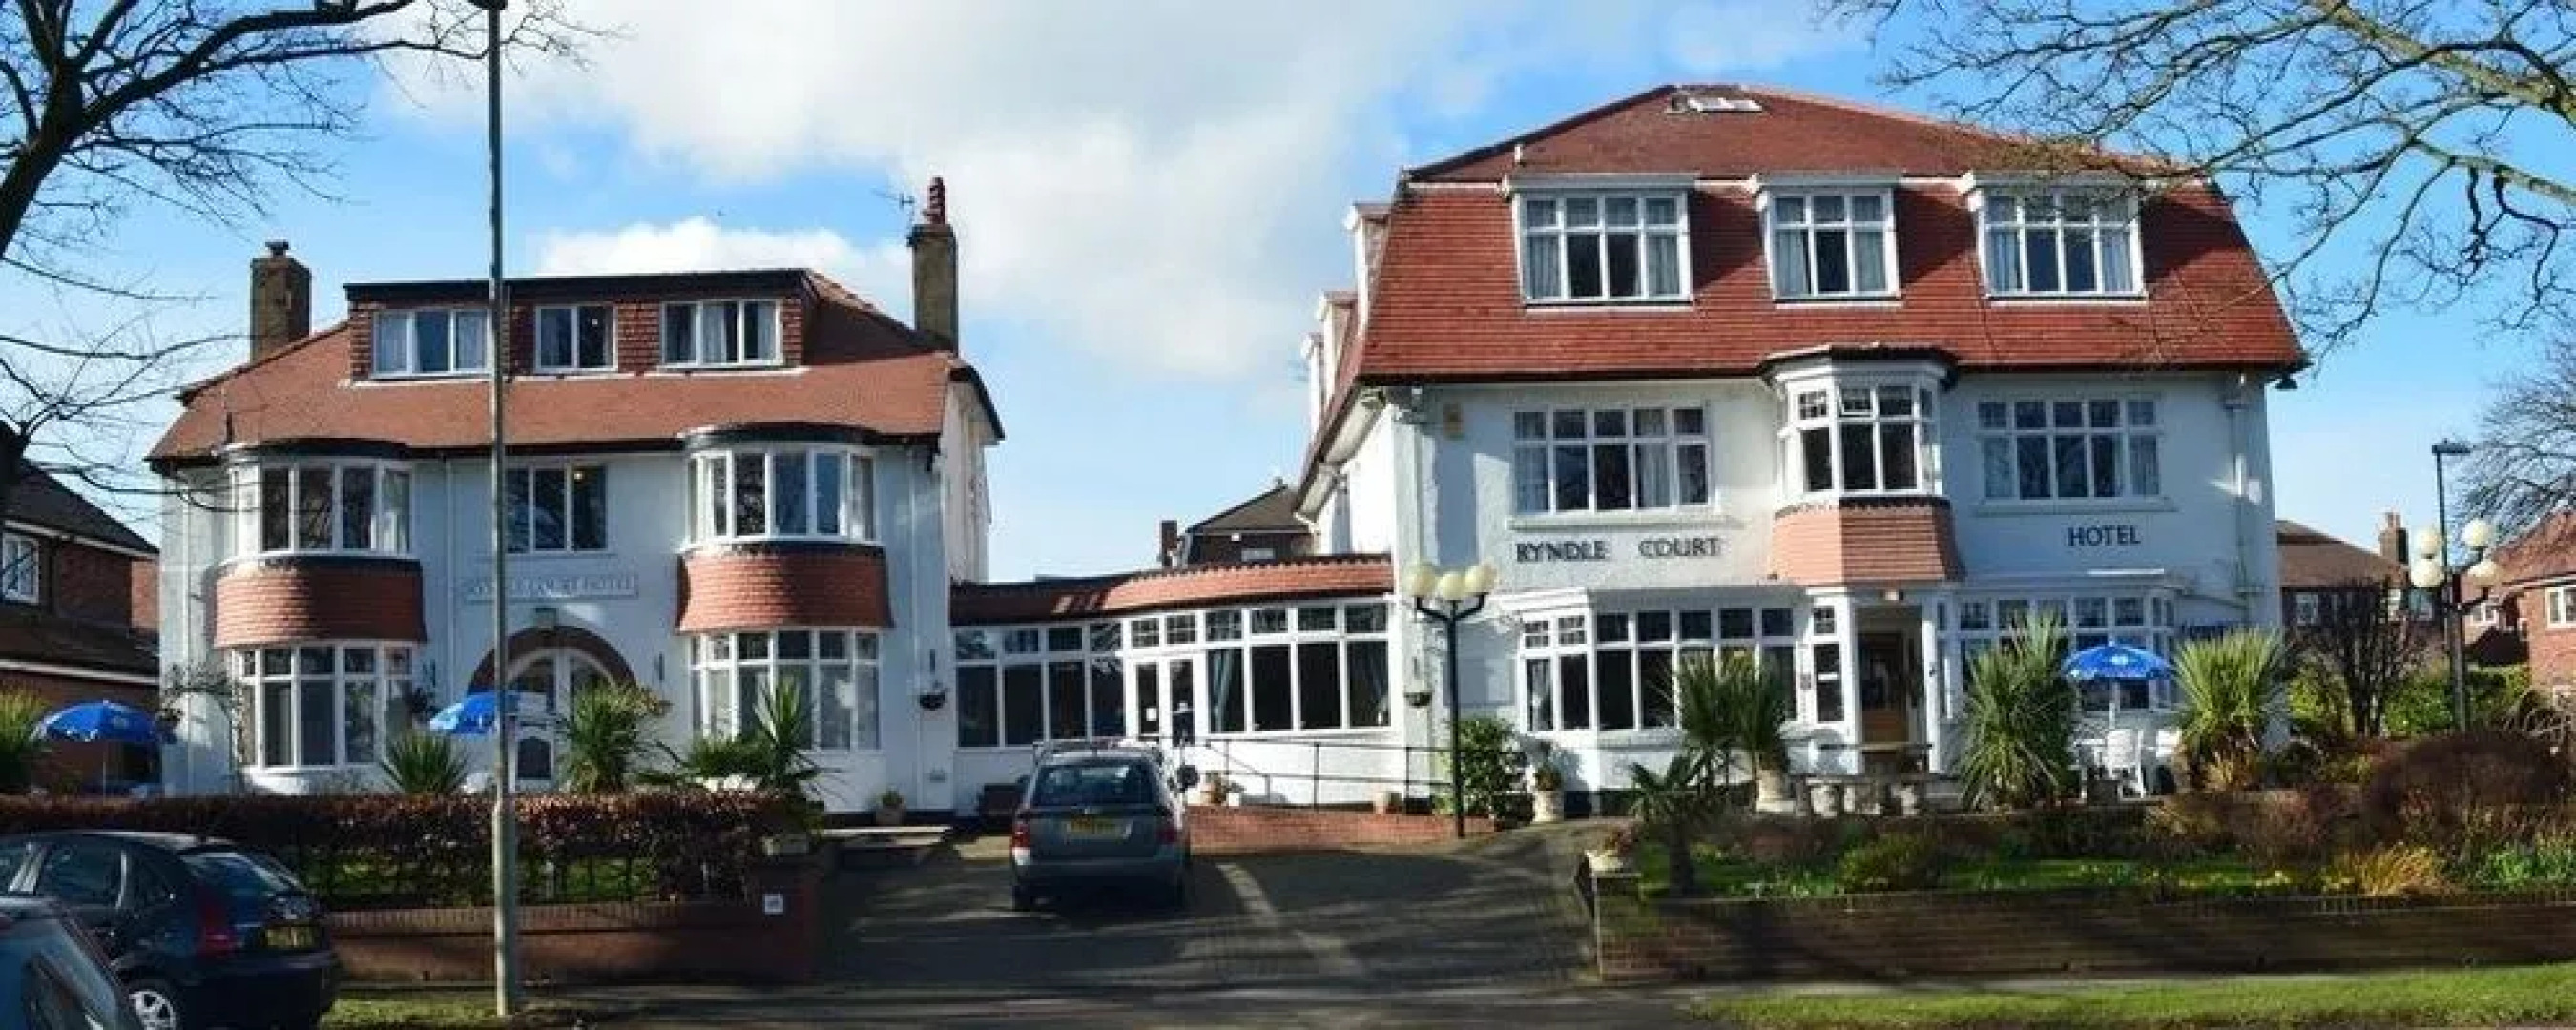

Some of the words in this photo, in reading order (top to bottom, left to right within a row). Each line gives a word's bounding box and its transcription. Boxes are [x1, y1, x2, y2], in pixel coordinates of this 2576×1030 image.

[2067, 525, 2142, 546] HOTEL
[1515, 539, 1607, 562] RYNDLE
[1637, 536, 1720, 558] COURT
